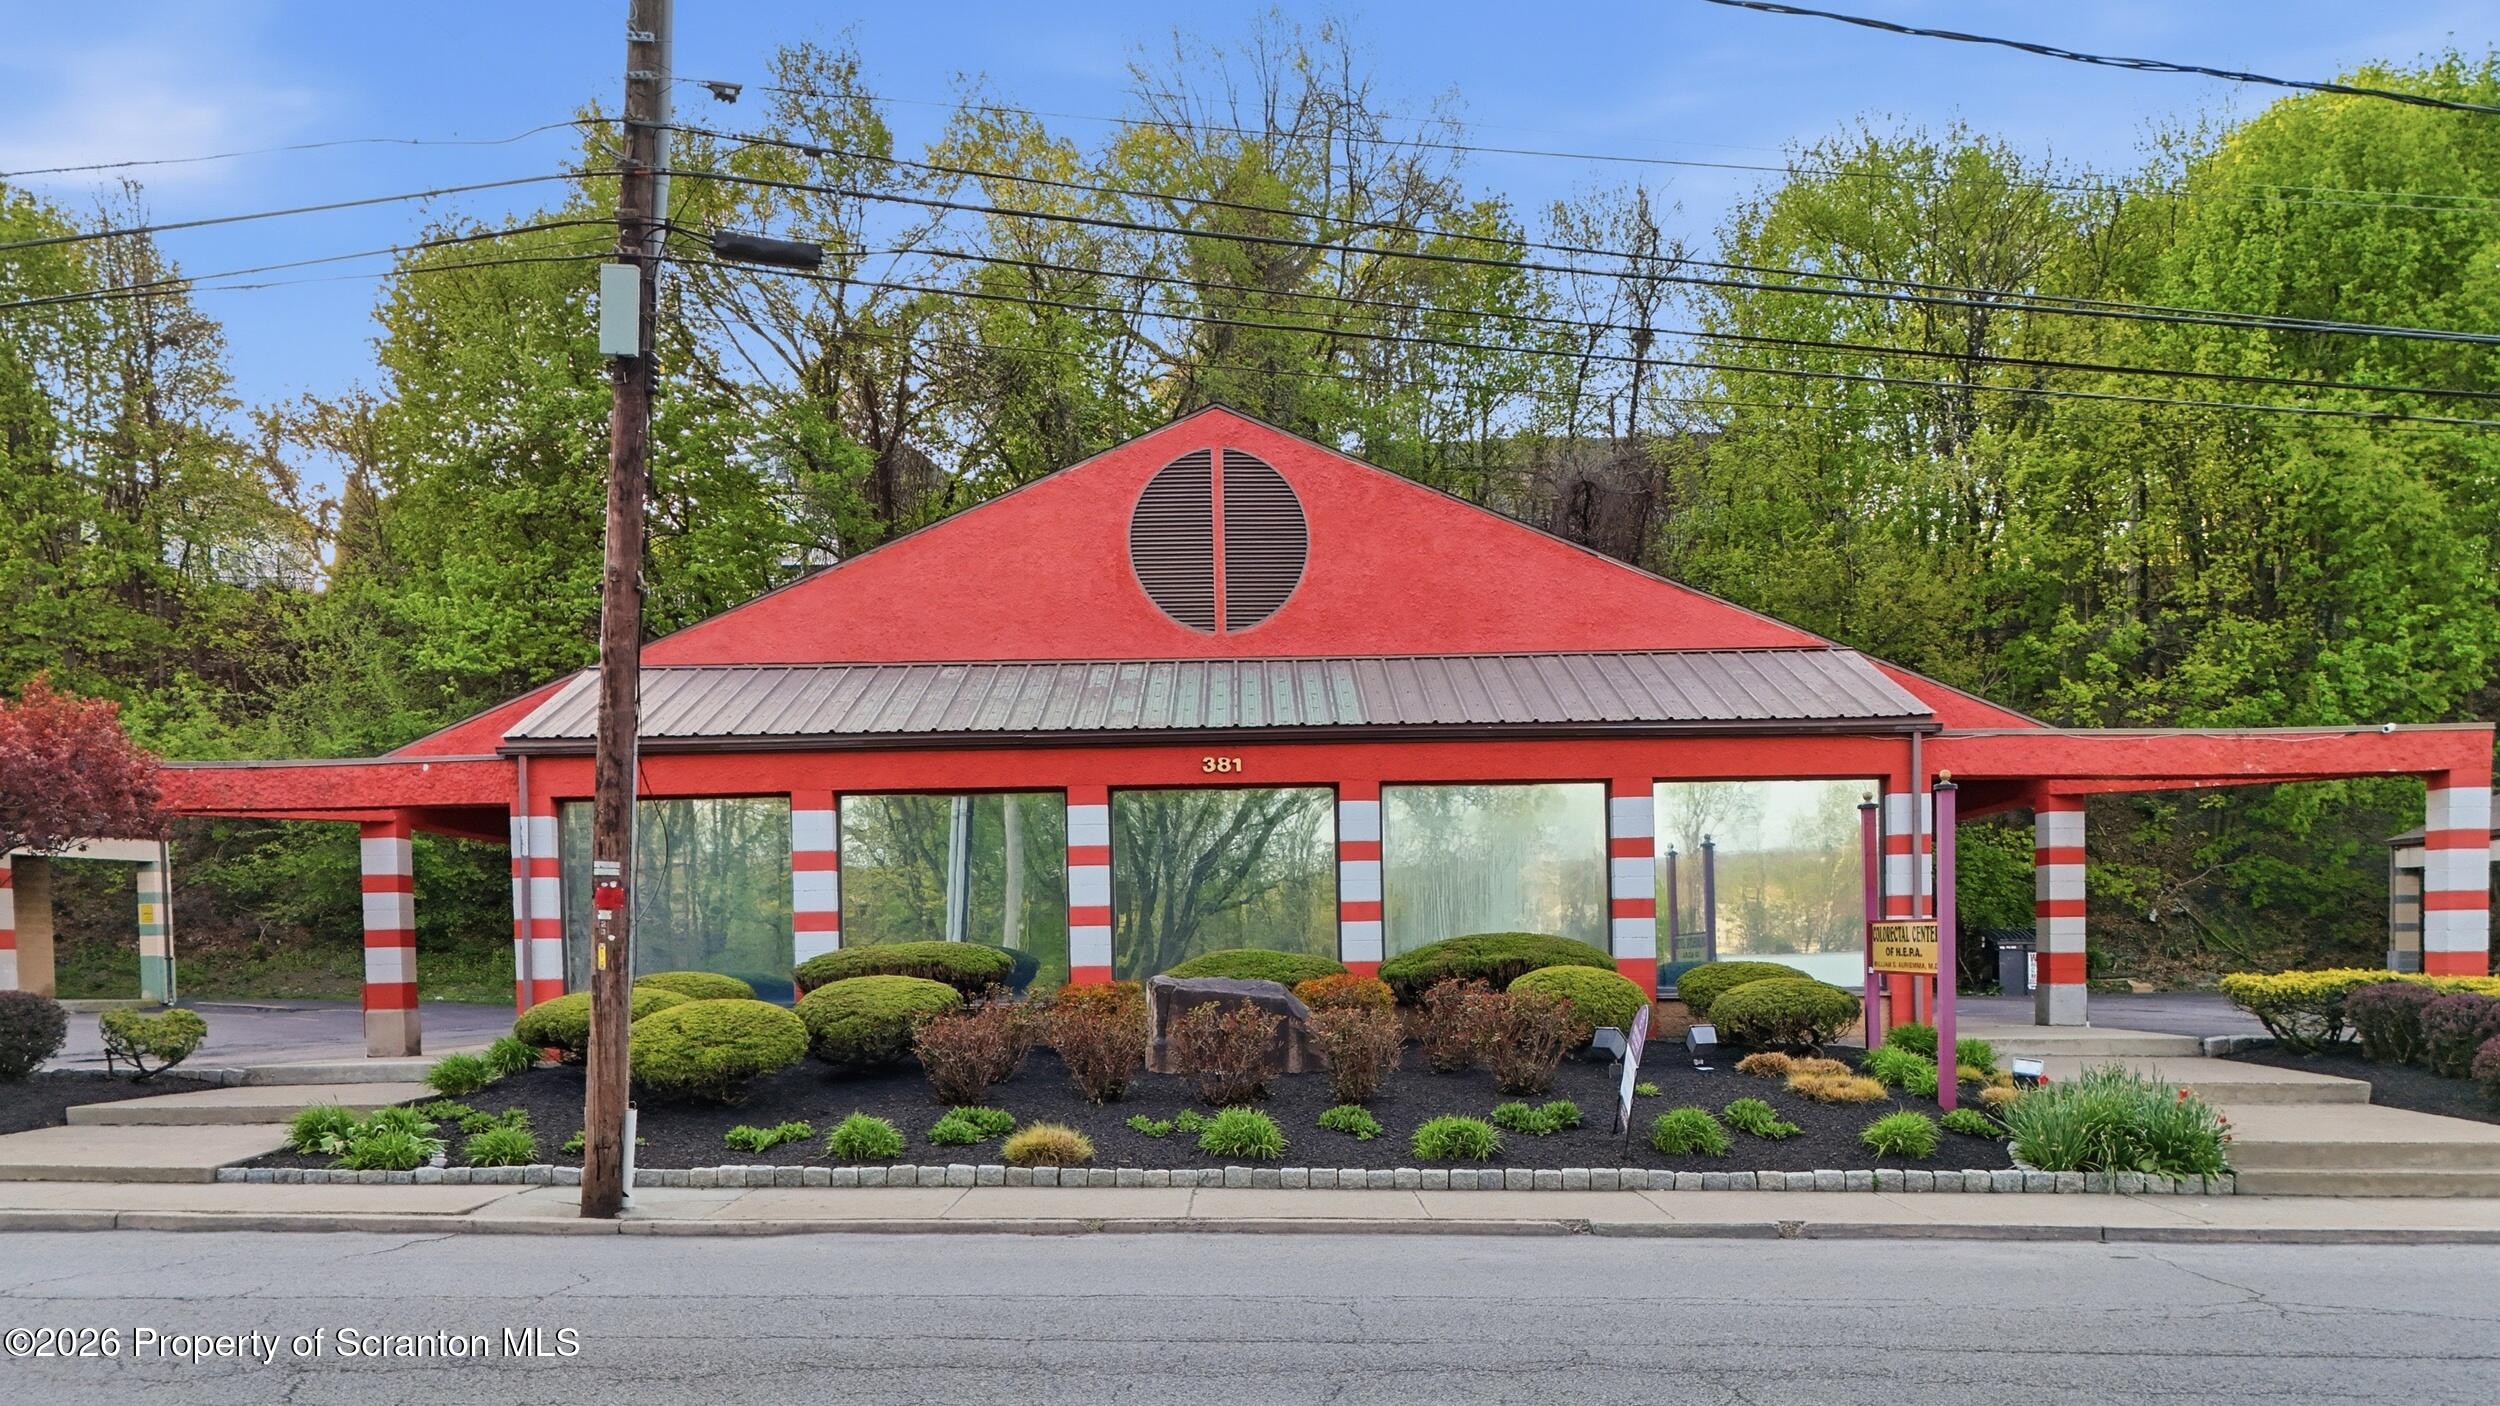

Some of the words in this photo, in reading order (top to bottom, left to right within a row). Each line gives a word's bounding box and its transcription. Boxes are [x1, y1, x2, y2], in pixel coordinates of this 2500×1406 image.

[1202, 756, 1242, 773] 381
[1873, 926, 1909, 943] COLORECTAL
[1885, 947, 1894, 956] OF
